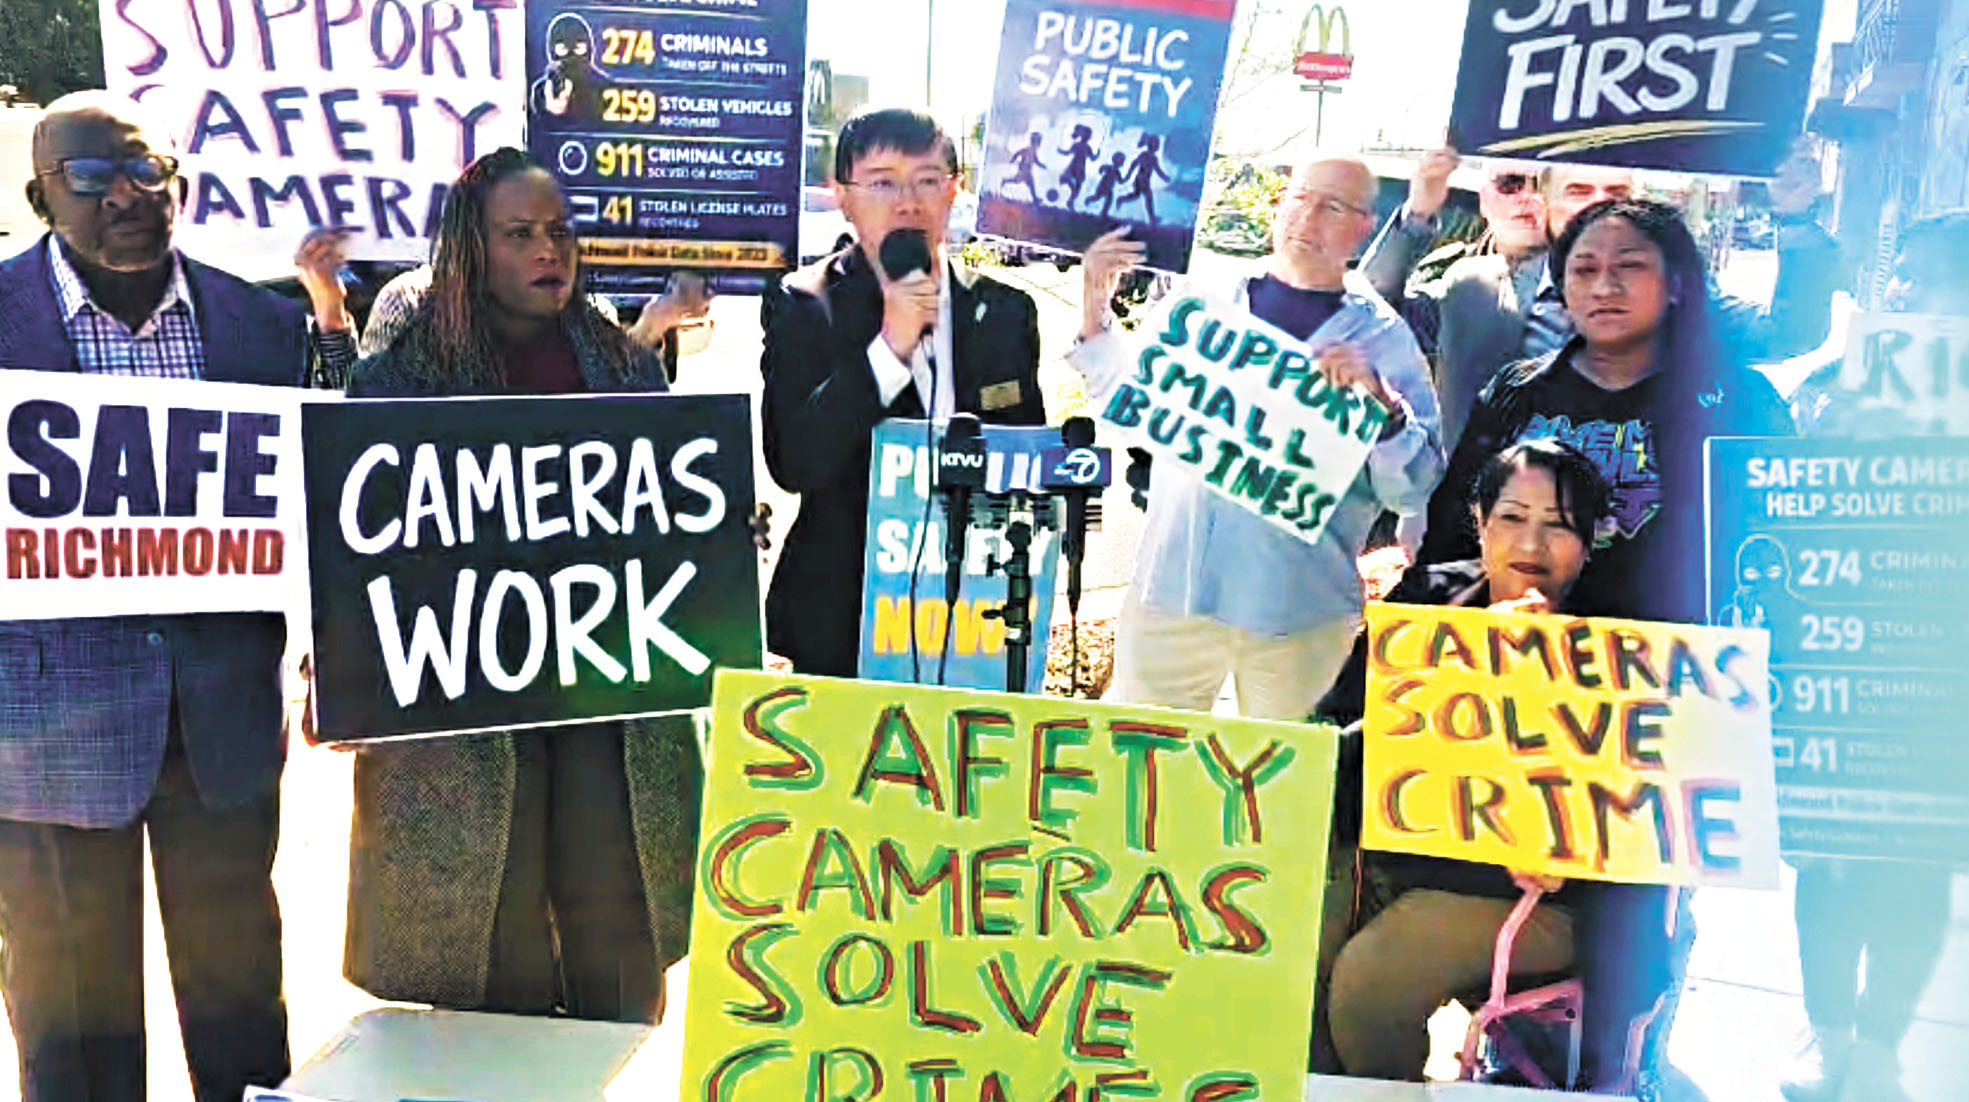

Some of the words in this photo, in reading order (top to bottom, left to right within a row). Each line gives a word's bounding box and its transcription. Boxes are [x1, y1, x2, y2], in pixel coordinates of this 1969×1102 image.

[115, 0, 517, 80] SUPPORT
[602, 28, 656, 65] 274
[660, 33, 768, 57] CRIMINALS
[1034, 11, 1189, 70] PUBLIC
[602, 89, 656, 122] 259
[659, 96, 718, 113] STOLEN
[722, 99, 793, 117] VEHICLES
[1019, 54, 1192, 118] SAFETY
[1498, 31, 1762, 130] FIRST
[596, 142, 643, 177] 911
[647, 146, 729, 165] CRIMINAL
[731, 150, 784, 166] CASES
[603, 196, 632, 226] 41
[639, 200, 687, 214] STOLEN
[690, 201, 740, 215] LICENSE
[743, 203, 787, 217] PLATES
[1134, 345, 1315, 469] SMALL
[7, 399, 280, 518] SAFE
[941, 452, 984, 468] KTVU
[1102, 384, 1335, 530] BUSINESS
[1747, 457, 1860, 488] SAFETY
[340, 438, 726, 554] CAMERAS
[1767, 491, 1826, 517] HELP
[1831, 491, 1905, 517] SOLVE
[6, 527, 284, 579] RICHMOND
[1798, 550, 1863, 587] 274
[367, 559, 711, 707] WORK
[1801, 614, 1866, 652] 259
[1373, 619, 1758, 713] CAMERAS
[1793, 675, 1849, 713] 911
[1382, 680, 1672, 772] SOLVE
[1801, 737, 1837, 772] 41
[744, 687, 1296, 852] SAFETY
[1379, 766, 1741, 874] CRIME
[702, 813, 1270, 956] CAMERAS
[722, 922, 1173, 1064] SOLVE
